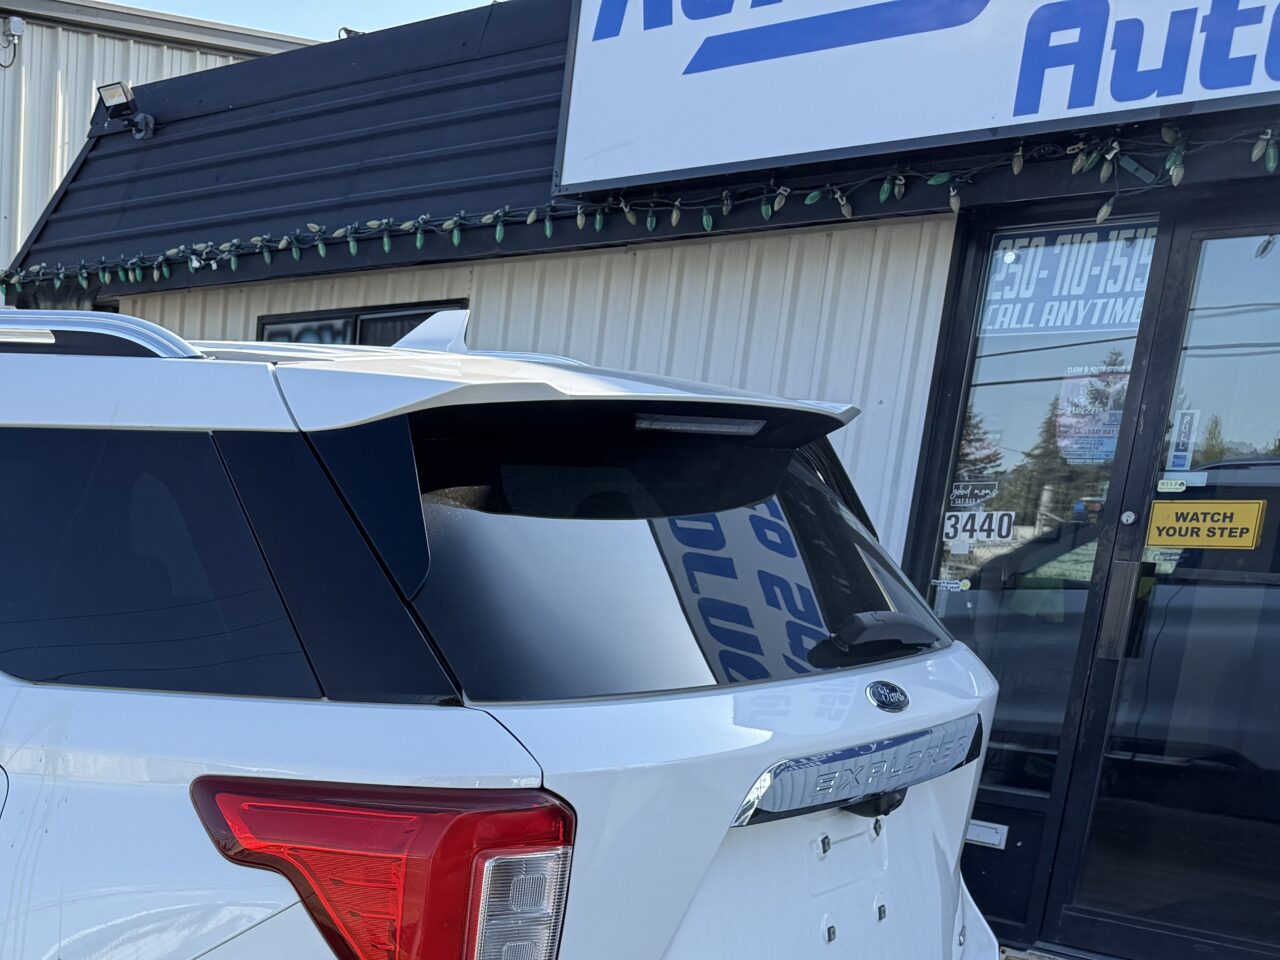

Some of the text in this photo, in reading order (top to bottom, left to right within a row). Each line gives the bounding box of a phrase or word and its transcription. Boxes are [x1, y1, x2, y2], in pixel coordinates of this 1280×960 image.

[1013, 0, 1280, 117] Aut
[982, 302, 1034, 329] CALL
[1179, 415, 1191, 449] PULL
[944, 512, 1013, 540] 3440
[1174, 511, 1235, 523] WATCH
[1156, 526, 1250, 538] YOUR STEP
[816, 735, 968, 795] EXPLORER
